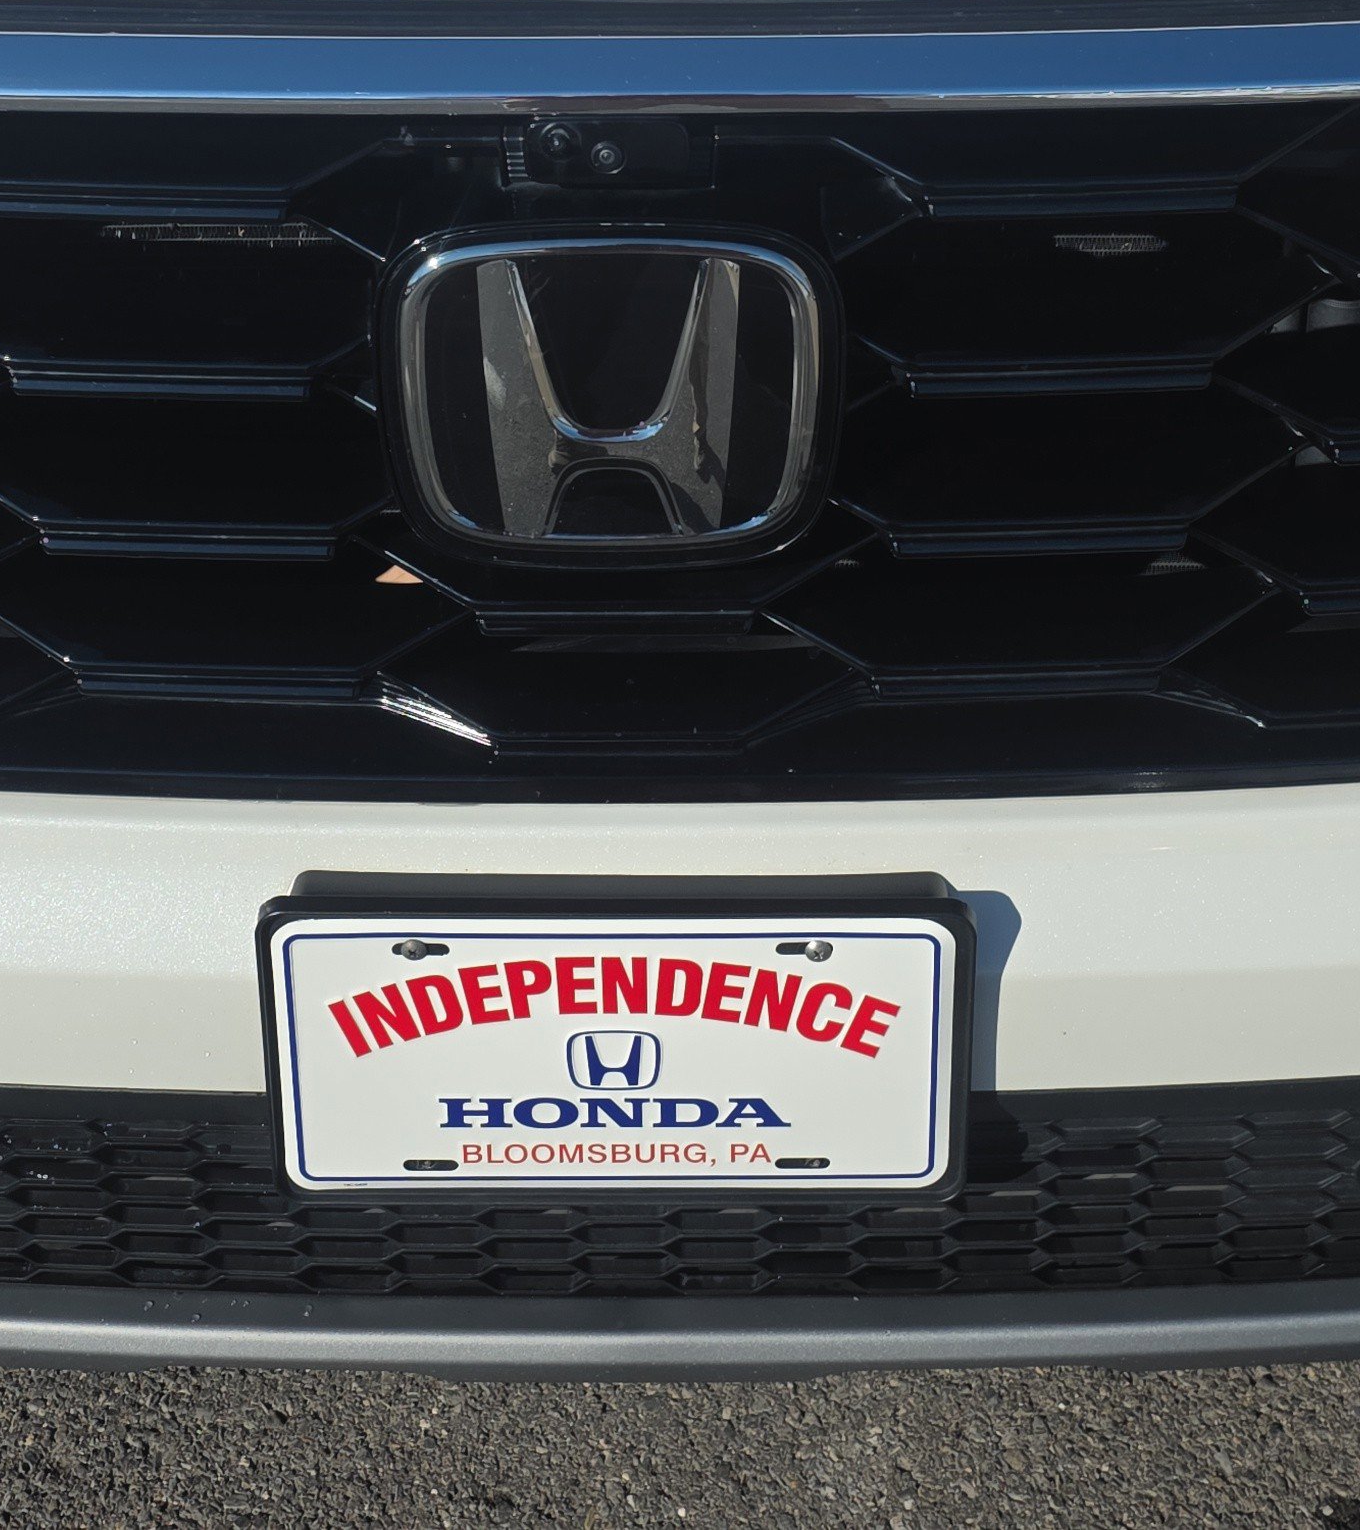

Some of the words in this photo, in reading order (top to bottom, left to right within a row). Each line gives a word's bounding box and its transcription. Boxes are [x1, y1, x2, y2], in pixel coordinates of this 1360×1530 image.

[328, 956, 901, 1058] INDEPENDENCE
[439, 1097, 792, 1129] HONDA
[461, 1142, 718, 1168] BLOOMSBURG,
[729, 1142, 773, 1164] PA
